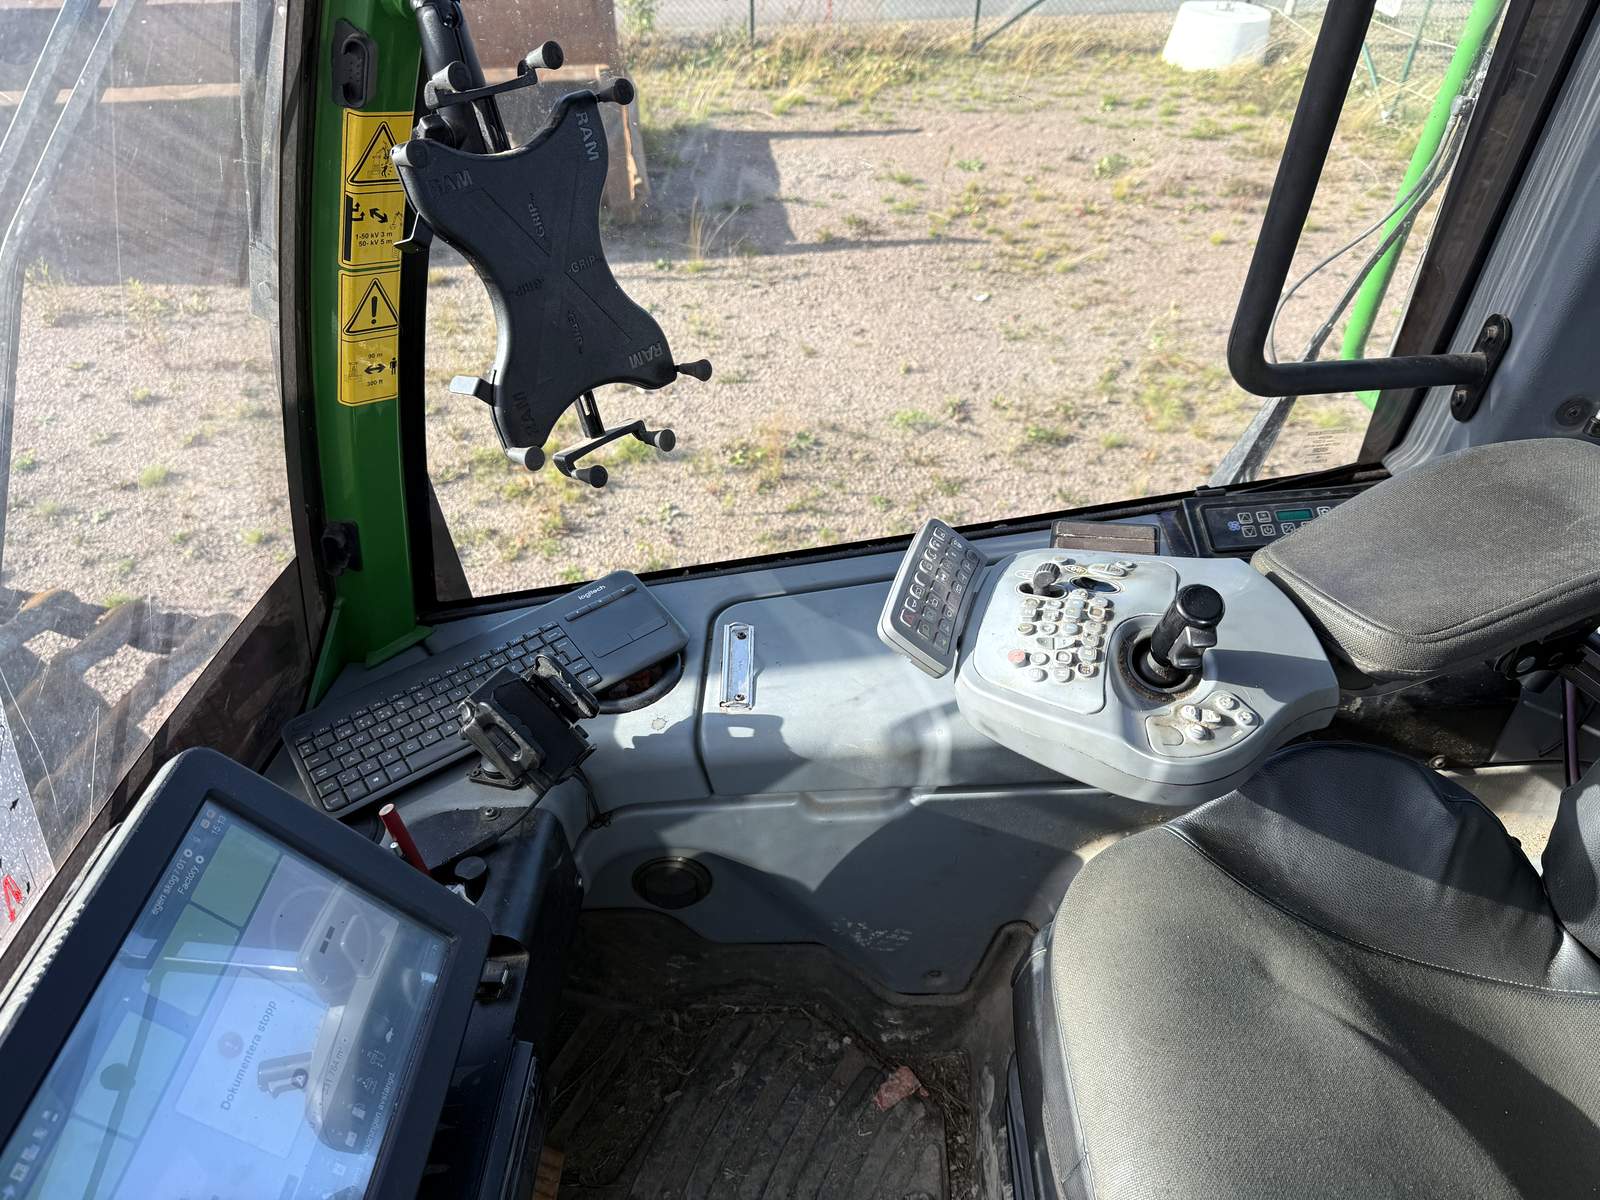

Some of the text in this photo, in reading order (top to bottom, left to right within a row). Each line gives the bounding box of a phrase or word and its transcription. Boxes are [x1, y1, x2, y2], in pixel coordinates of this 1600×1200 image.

[574, 111, 600, 162] RAM
[355, 232, 370, 240] 1-50
[370, 231, 380, 239] kV
[628, 339, 664, 370] RAM
[577, 584, 607, 600] logitech
[164, 872, 181, 896] skog
[177, 864, 200, 896] Factory
[220, 999, 278, 1111] Dokumentera stopp
